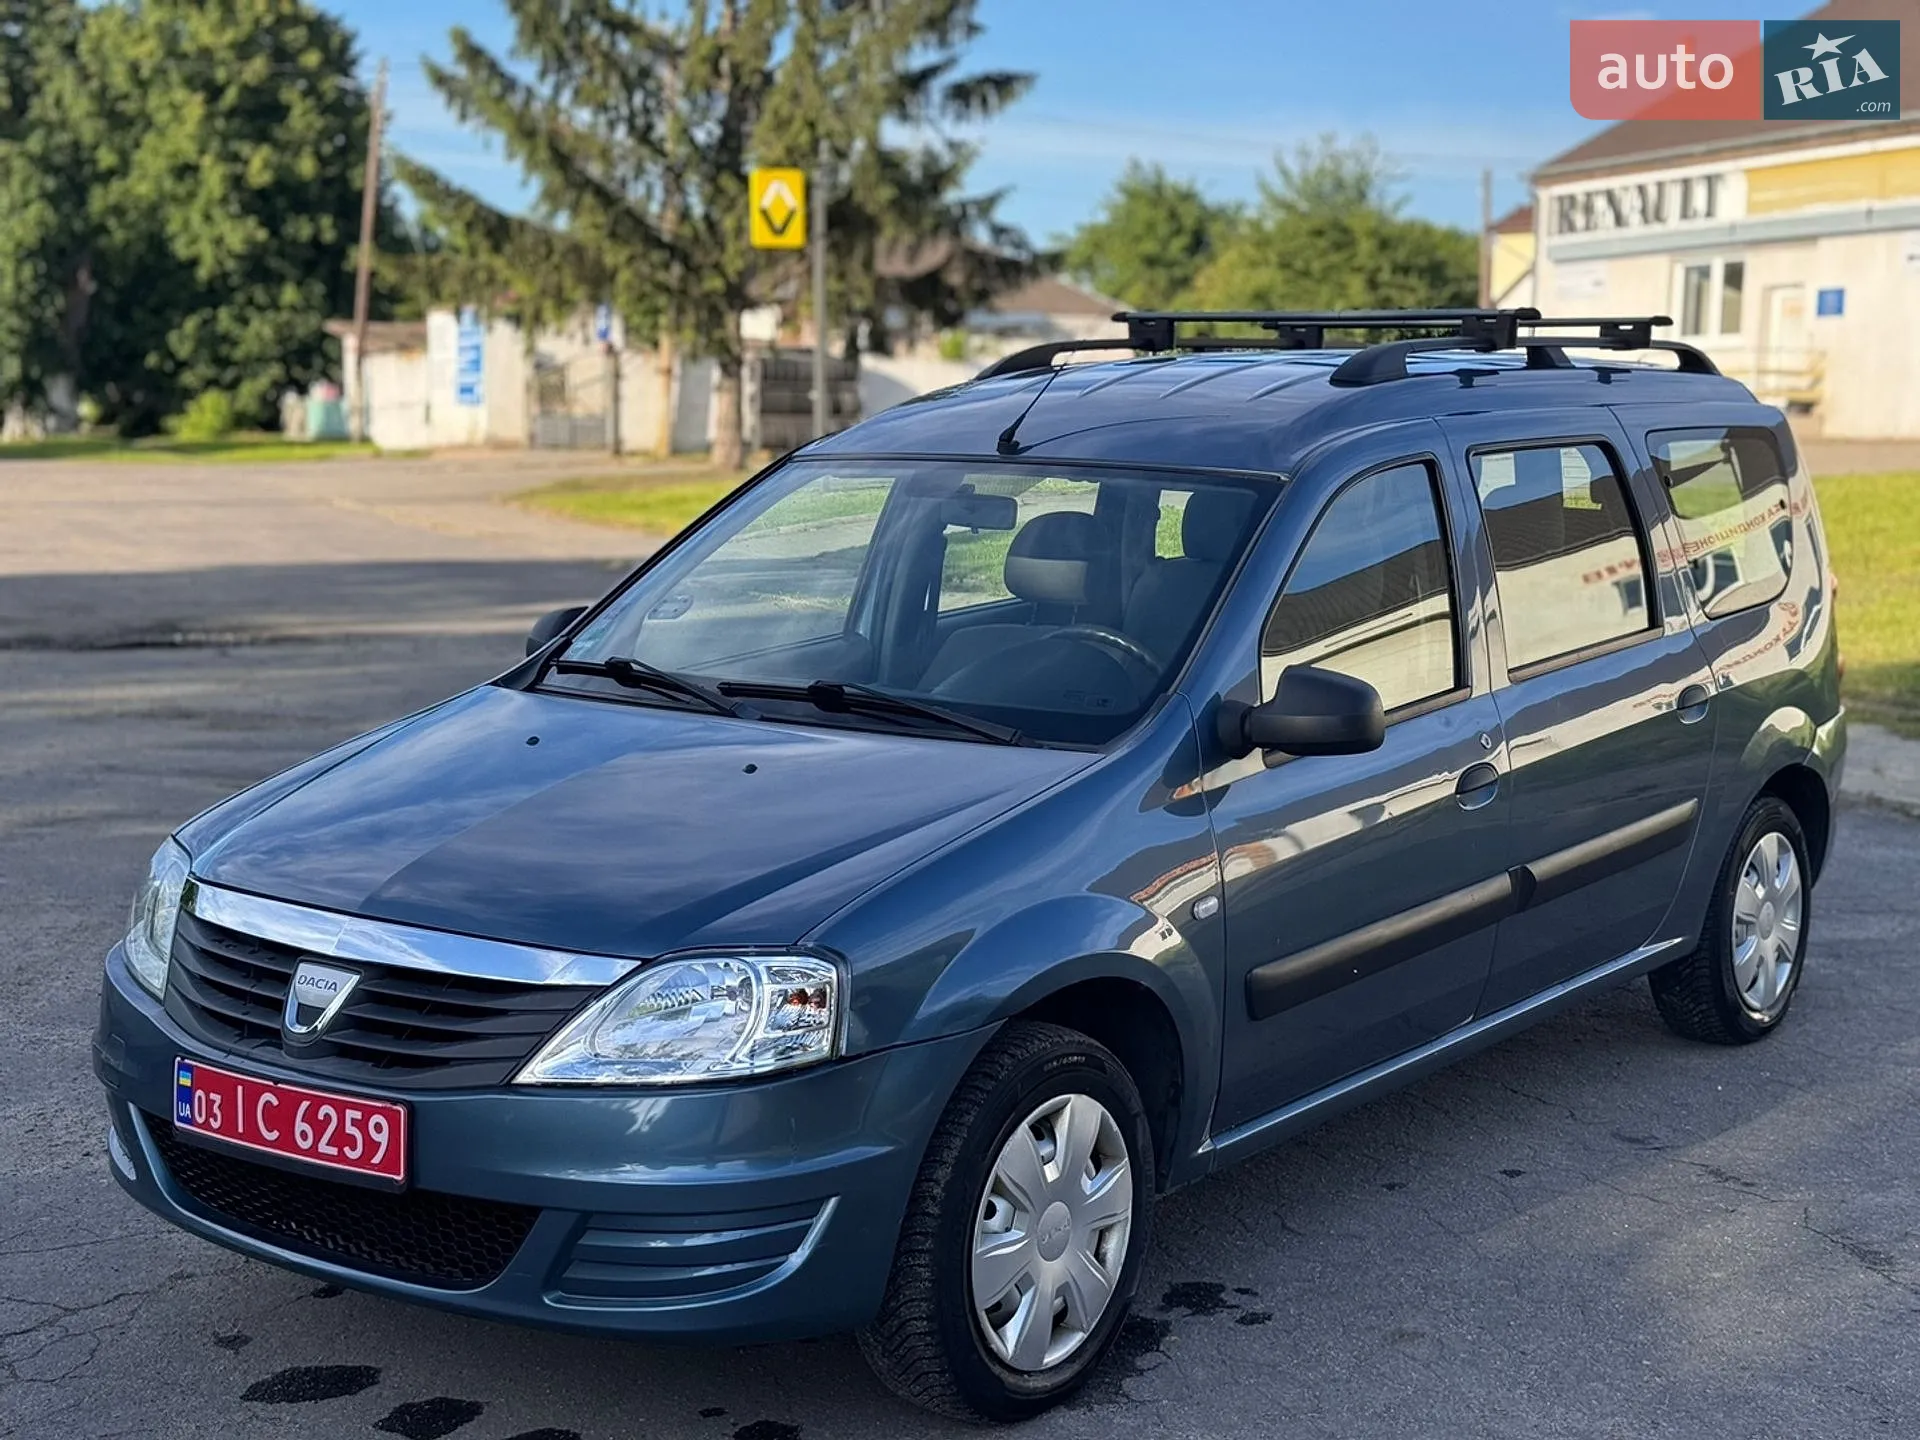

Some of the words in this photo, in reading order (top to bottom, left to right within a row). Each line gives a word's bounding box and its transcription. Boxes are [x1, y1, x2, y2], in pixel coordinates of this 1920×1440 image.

[1555, 173, 1725, 234] RENAULT
[297, 974, 338, 992] DACIA
[178, 1100, 192, 1119] UA
[194, 1089, 222, 1129] 03
[237, 1085, 280, 1141] IC
[294, 1100, 390, 1165] 6259
